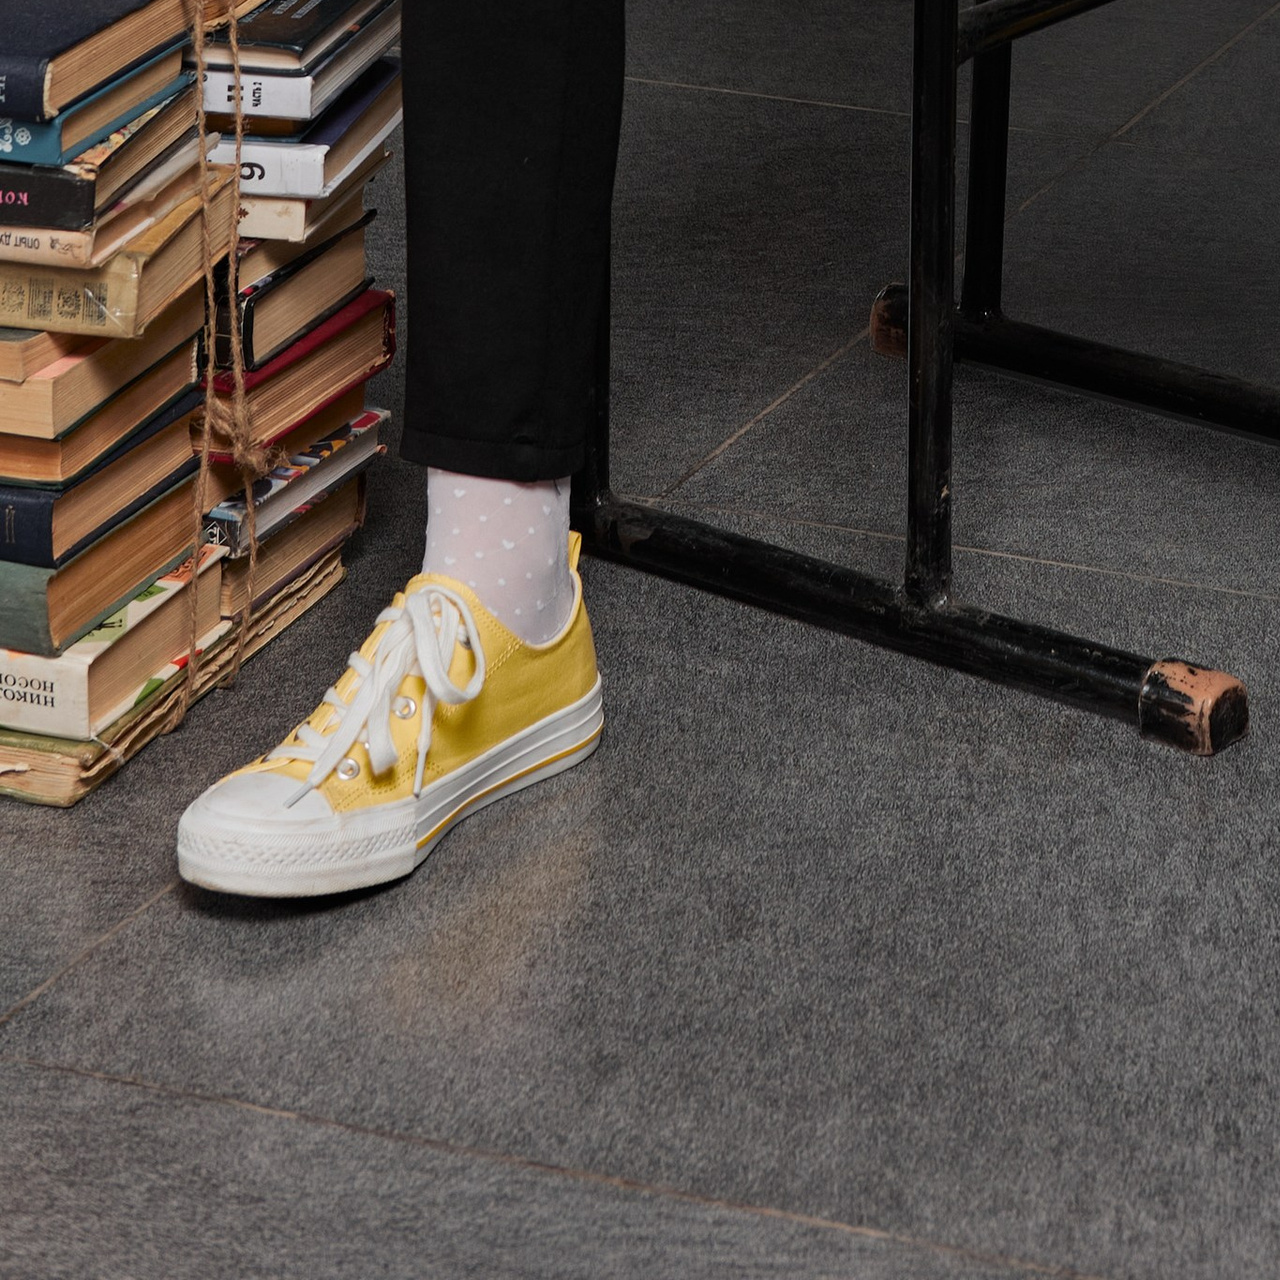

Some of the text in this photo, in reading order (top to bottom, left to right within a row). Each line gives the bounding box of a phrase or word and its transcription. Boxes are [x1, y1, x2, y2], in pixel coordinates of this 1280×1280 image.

[251, 87, 263, 108] ЧАСТЬ
[14, 235, 41, 251] ОПЫТ
[0, 687, 56, 708] НИКО
